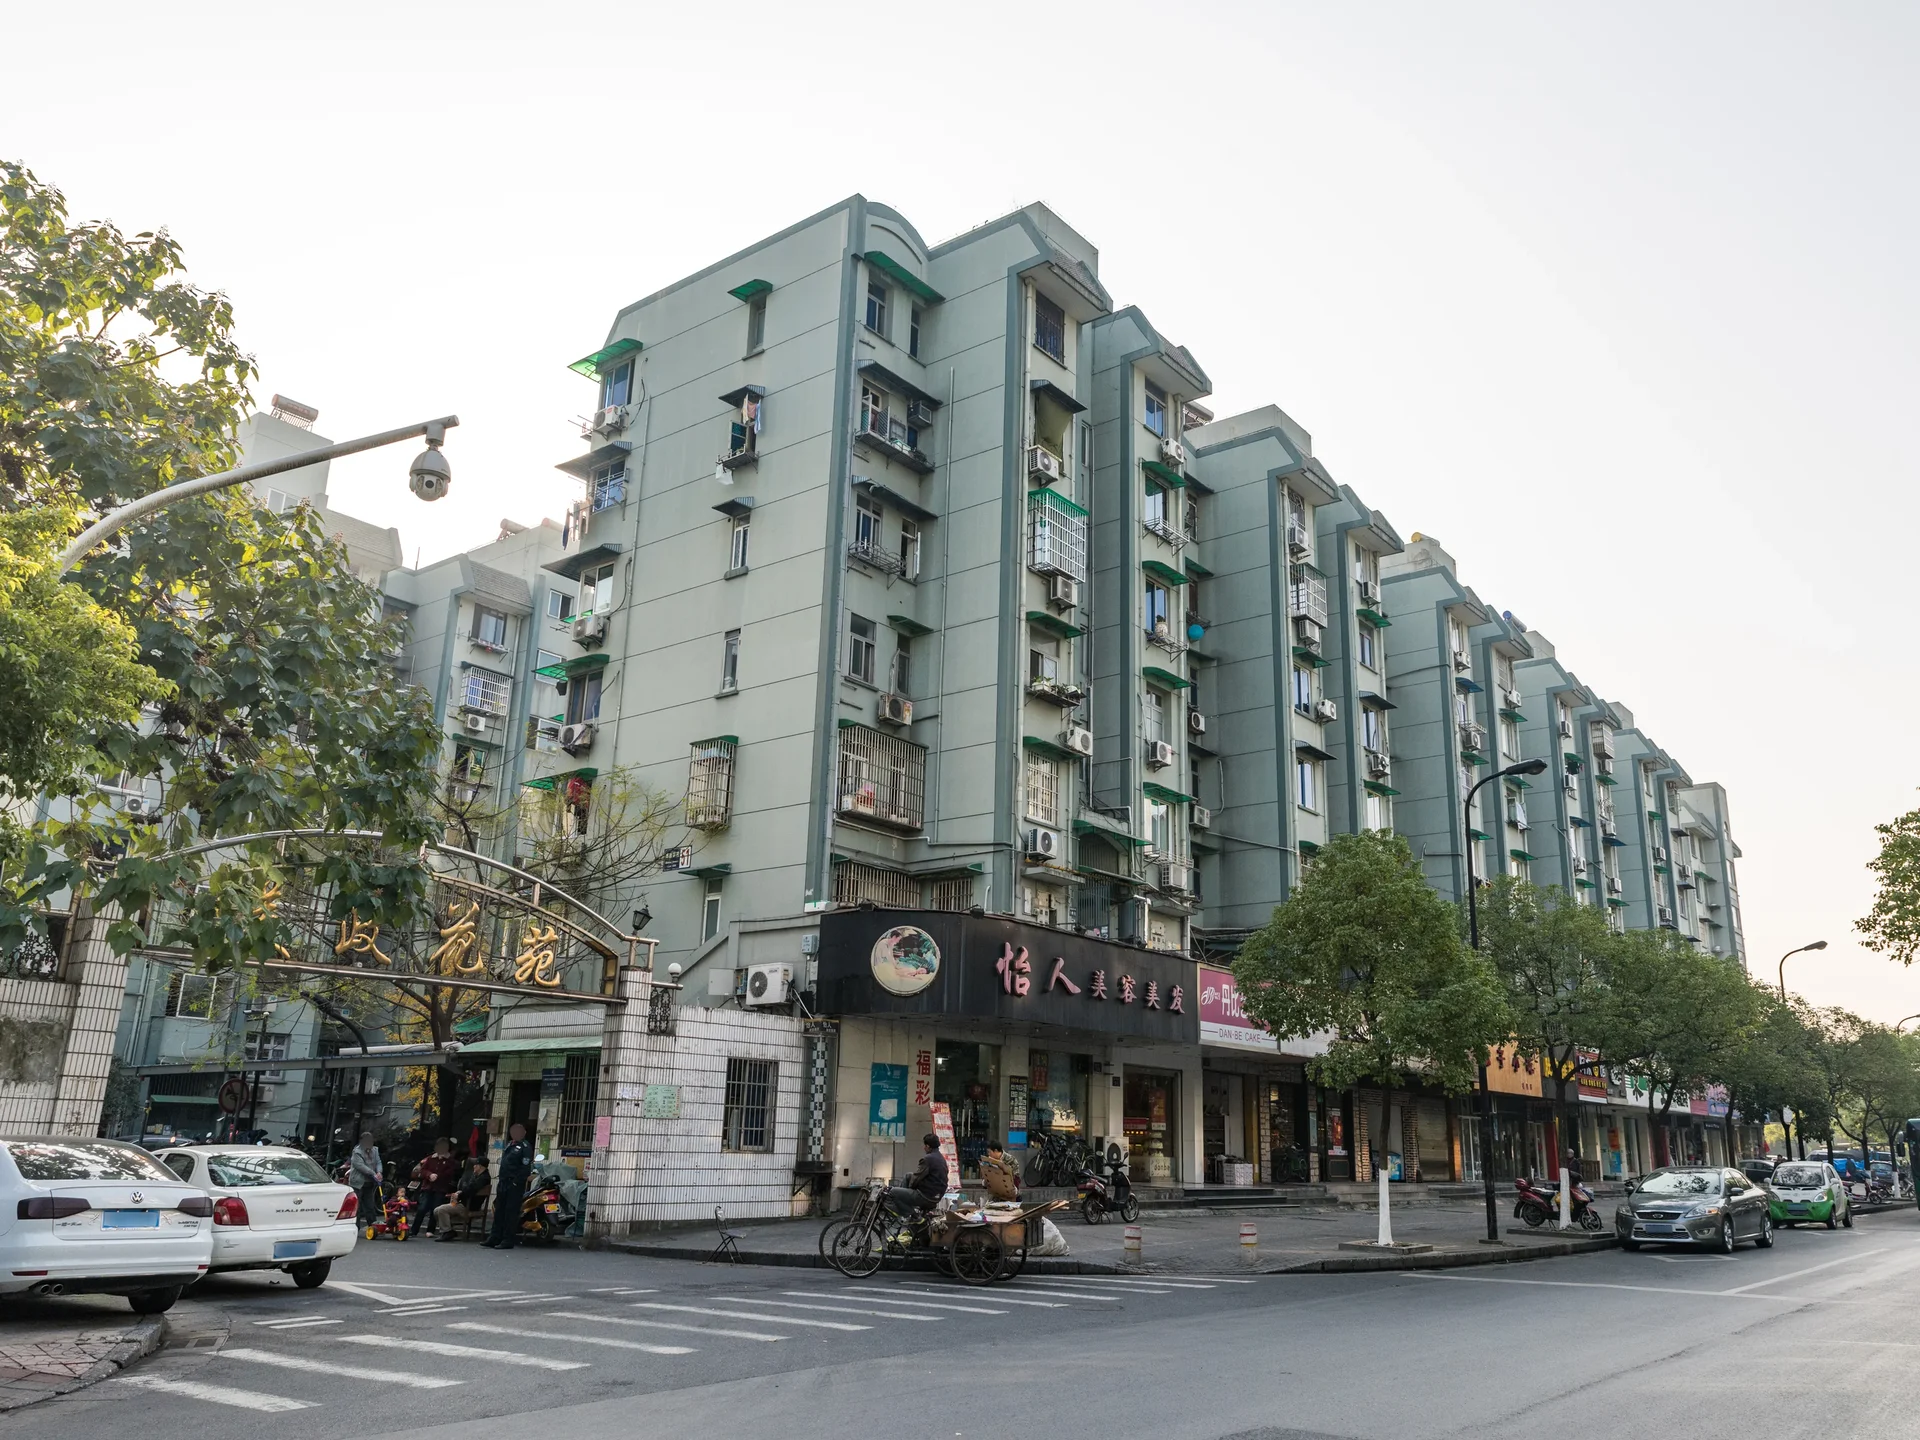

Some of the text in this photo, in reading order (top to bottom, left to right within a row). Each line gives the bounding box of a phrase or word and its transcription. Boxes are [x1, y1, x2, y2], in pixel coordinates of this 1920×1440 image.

[996, 942, 1185, 1014] 怡人美容美发
[1219, 1028, 1261, 1043] DAN-BE CAKE
[915, 1050, 932, 1105] 福彩
